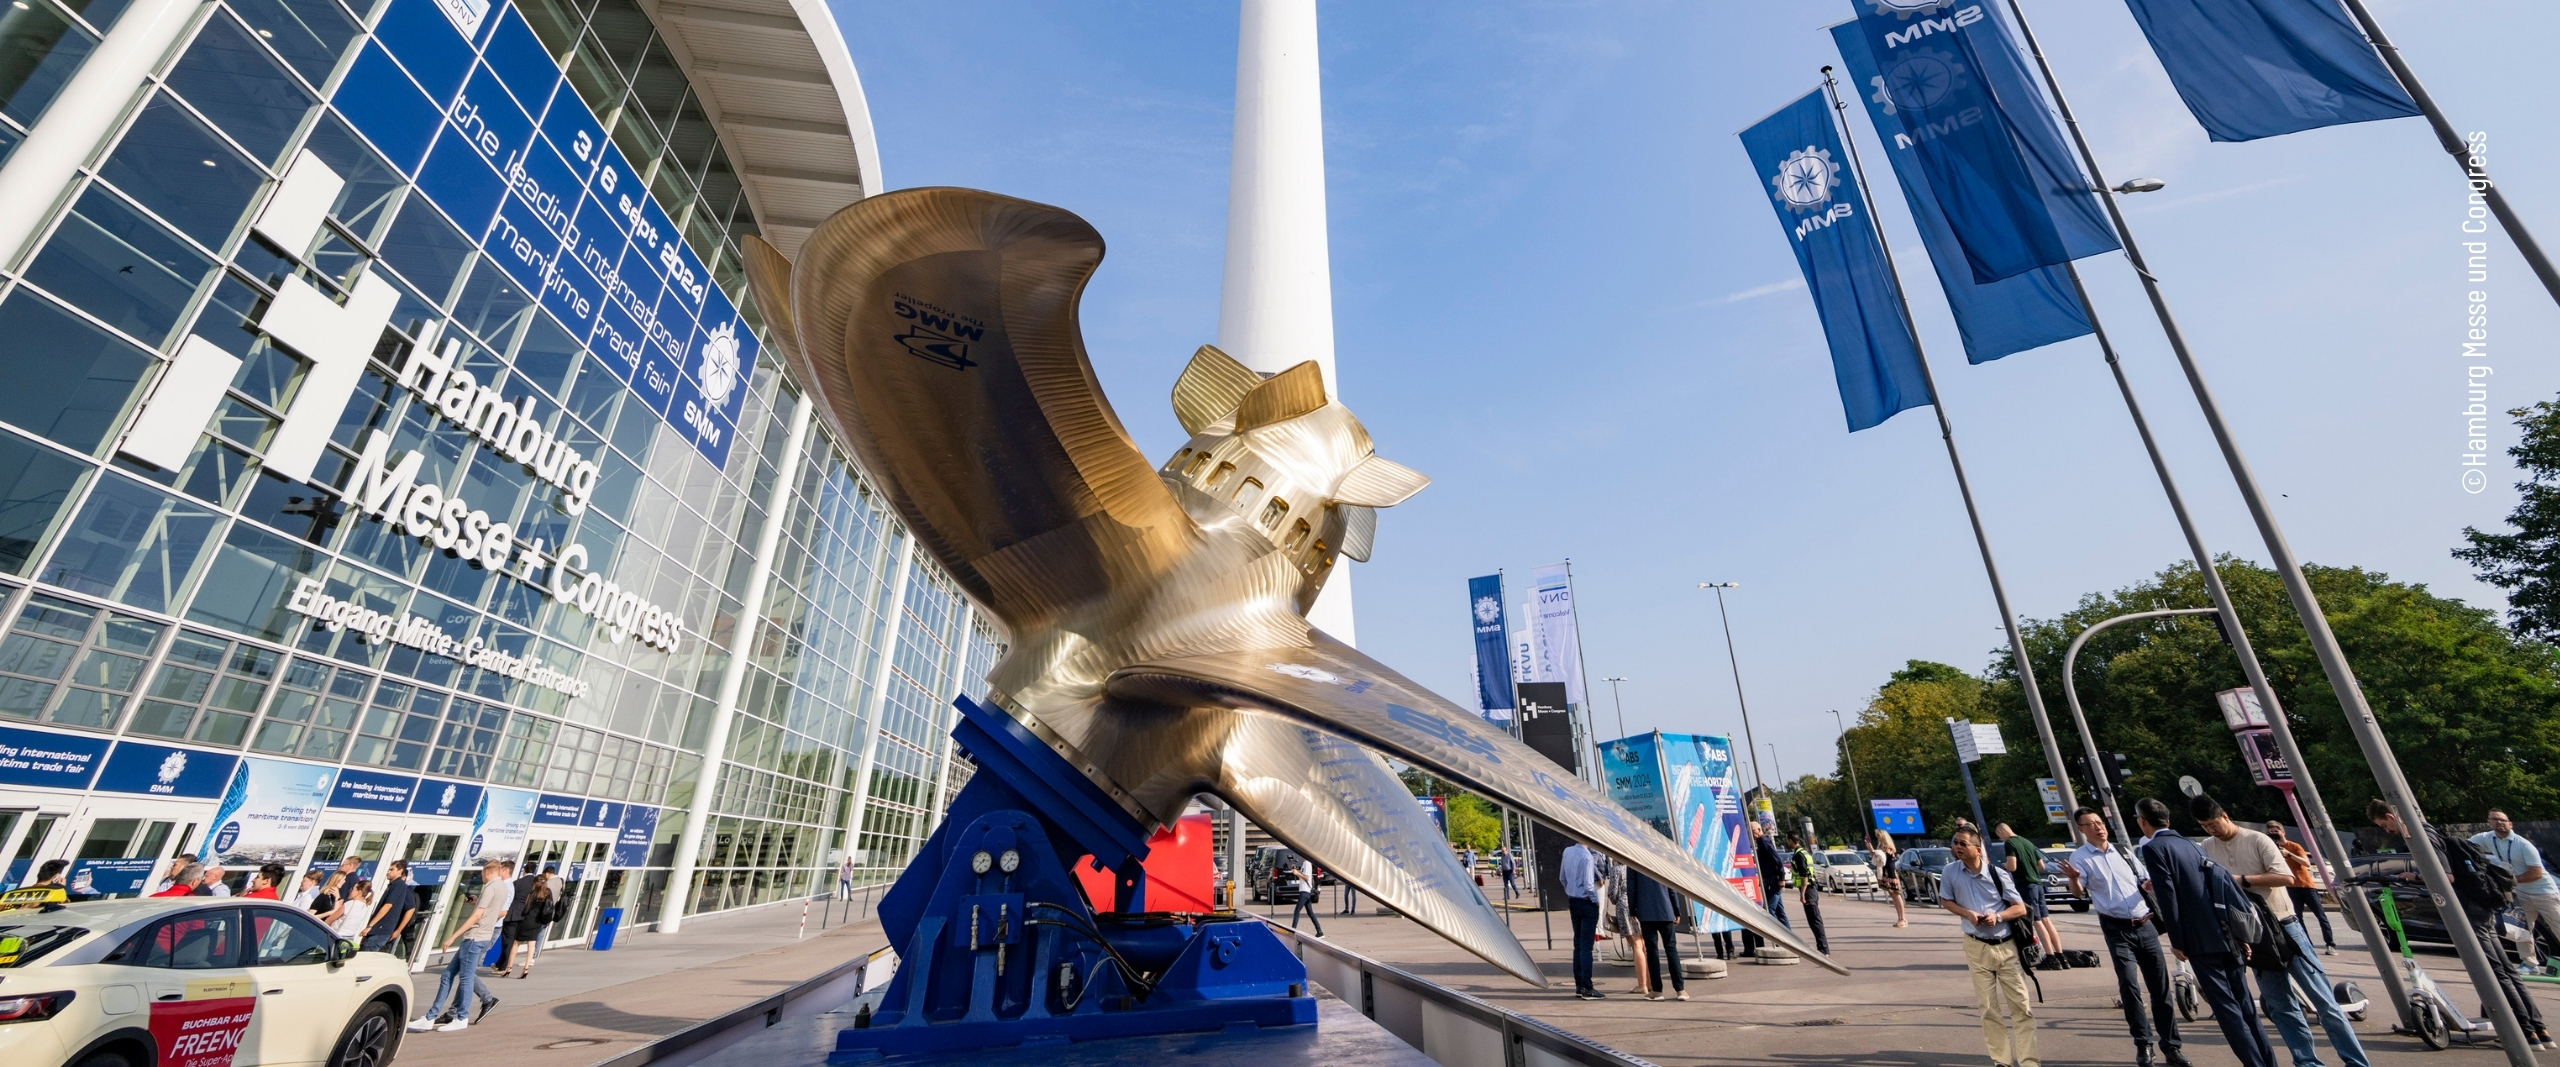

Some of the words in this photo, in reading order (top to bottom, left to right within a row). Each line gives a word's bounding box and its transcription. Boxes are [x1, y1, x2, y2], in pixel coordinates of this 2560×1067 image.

[450, 0, 474, 26] DNV
[454, 94, 499, 158] the
[504, 150, 581, 252] leading
[584, 237, 686, 361] international
[618, 194, 659, 249] sept
[660, 242, 703, 305] 2024
[493, 214, 590, 320] maritime
[595, 312, 642, 370] trade
[643, 361, 670, 396] fair
[894, 291, 955, 319] Propeller
[893, 300, 985, 342] MMG
[960, 314, 986, 328] The
[397, 318, 601, 516] Hamburg
[683, 400, 721, 447] SMM
[341, 429, 512, 571] Messe
[551, 543, 685, 654] Congress
[287, 577, 394, 645] Eingang
[393, 611, 452, 657] Mitte
[464, 636, 530, 680] Central
[528, 657, 588, 699] Entrance
[20, 747, 92, 762] international
[1626, 751, 1640, 764] ABS
[1711, 749, 1728, 761] ABS
[32, 761, 63, 772] trade
[65, 764, 85, 773] fair
[150, 784, 175, 794] SMM
[353, 782, 373, 791] leading
[374, 784, 408, 794] international
[1616, 776, 1632, 789] SMM
[1633, 774, 1651, 788] 2024
[352, 792, 378, 800] maritime
[379, 794, 394, 802] trade
[247, 813, 279, 821] maritime
[281, 814, 313, 822] transition
[281, 806, 304, 815] driving
[11, 890, 46, 902] TAXI
[182, 1016, 230, 1030] BUCHBAR
[232, 1013, 252, 1024] AUF
